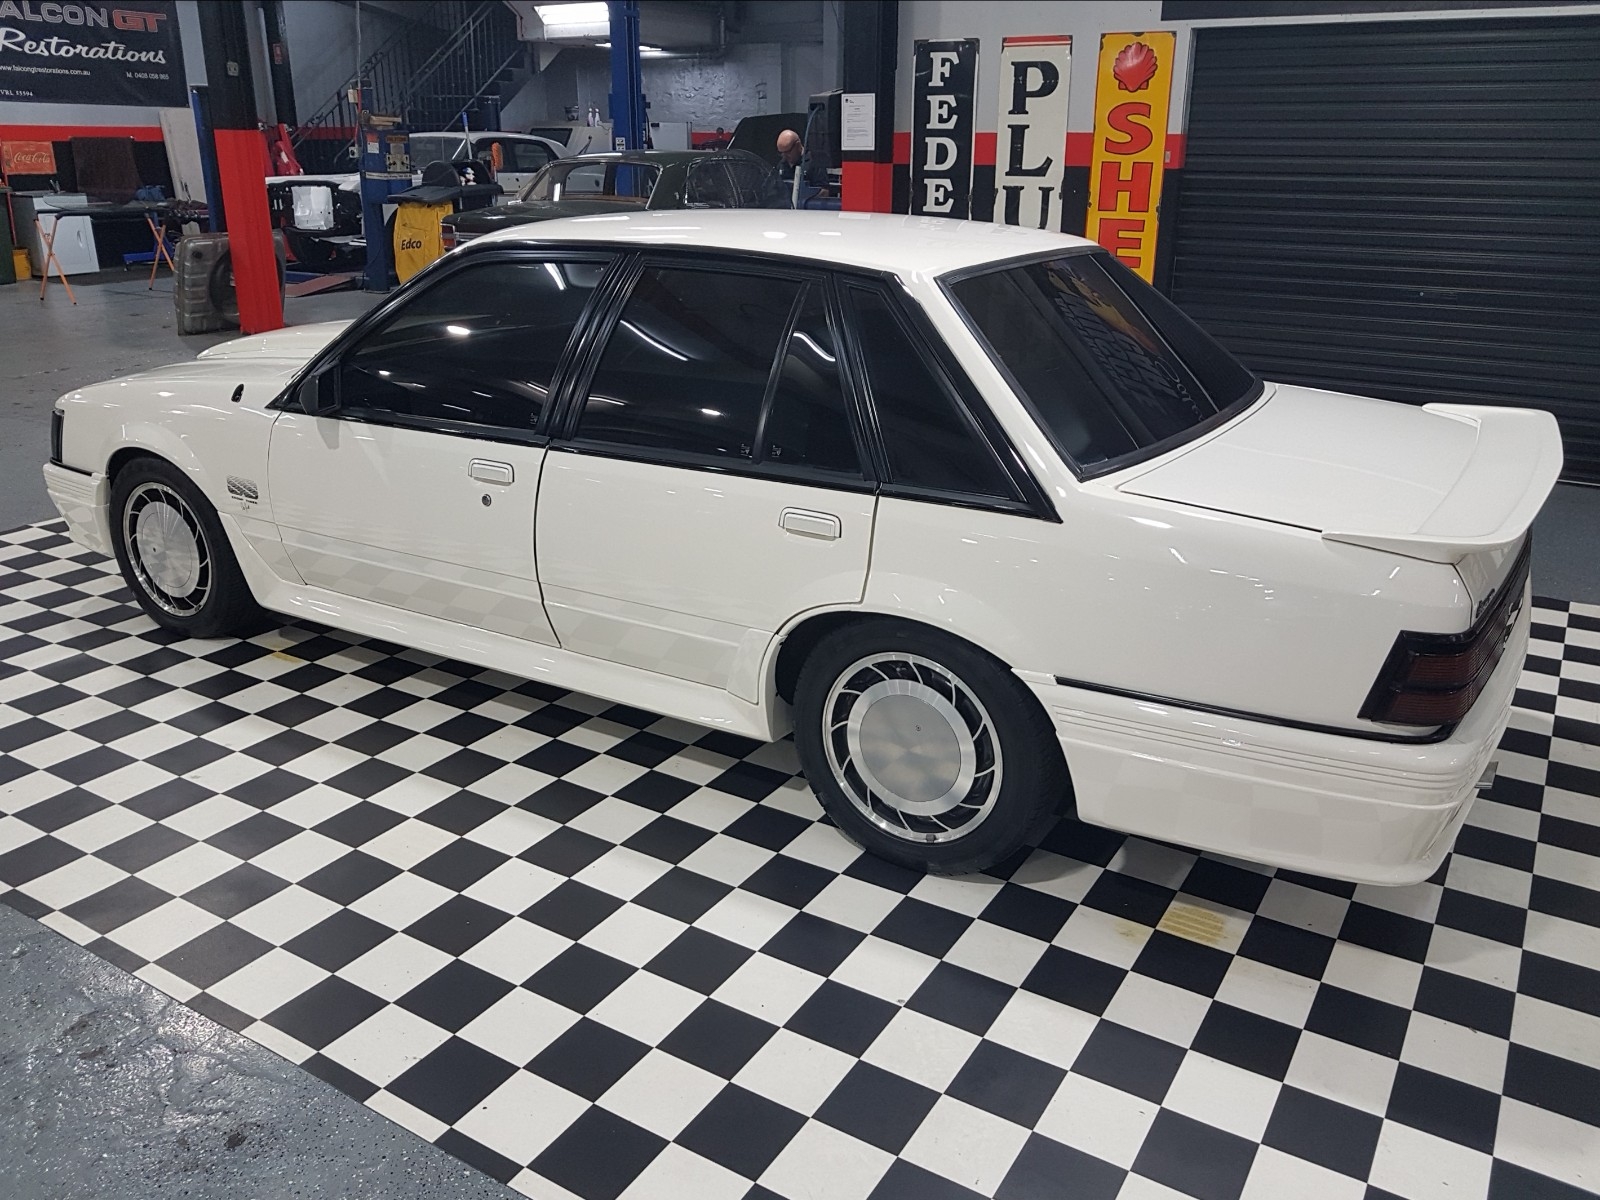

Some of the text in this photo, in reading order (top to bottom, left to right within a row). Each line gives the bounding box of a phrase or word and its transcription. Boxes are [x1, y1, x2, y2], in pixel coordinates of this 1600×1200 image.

[112, 9, 167, 33] GT
[0, 27, 166, 65] Restorations
[401, 238, 422, 251] Edco
